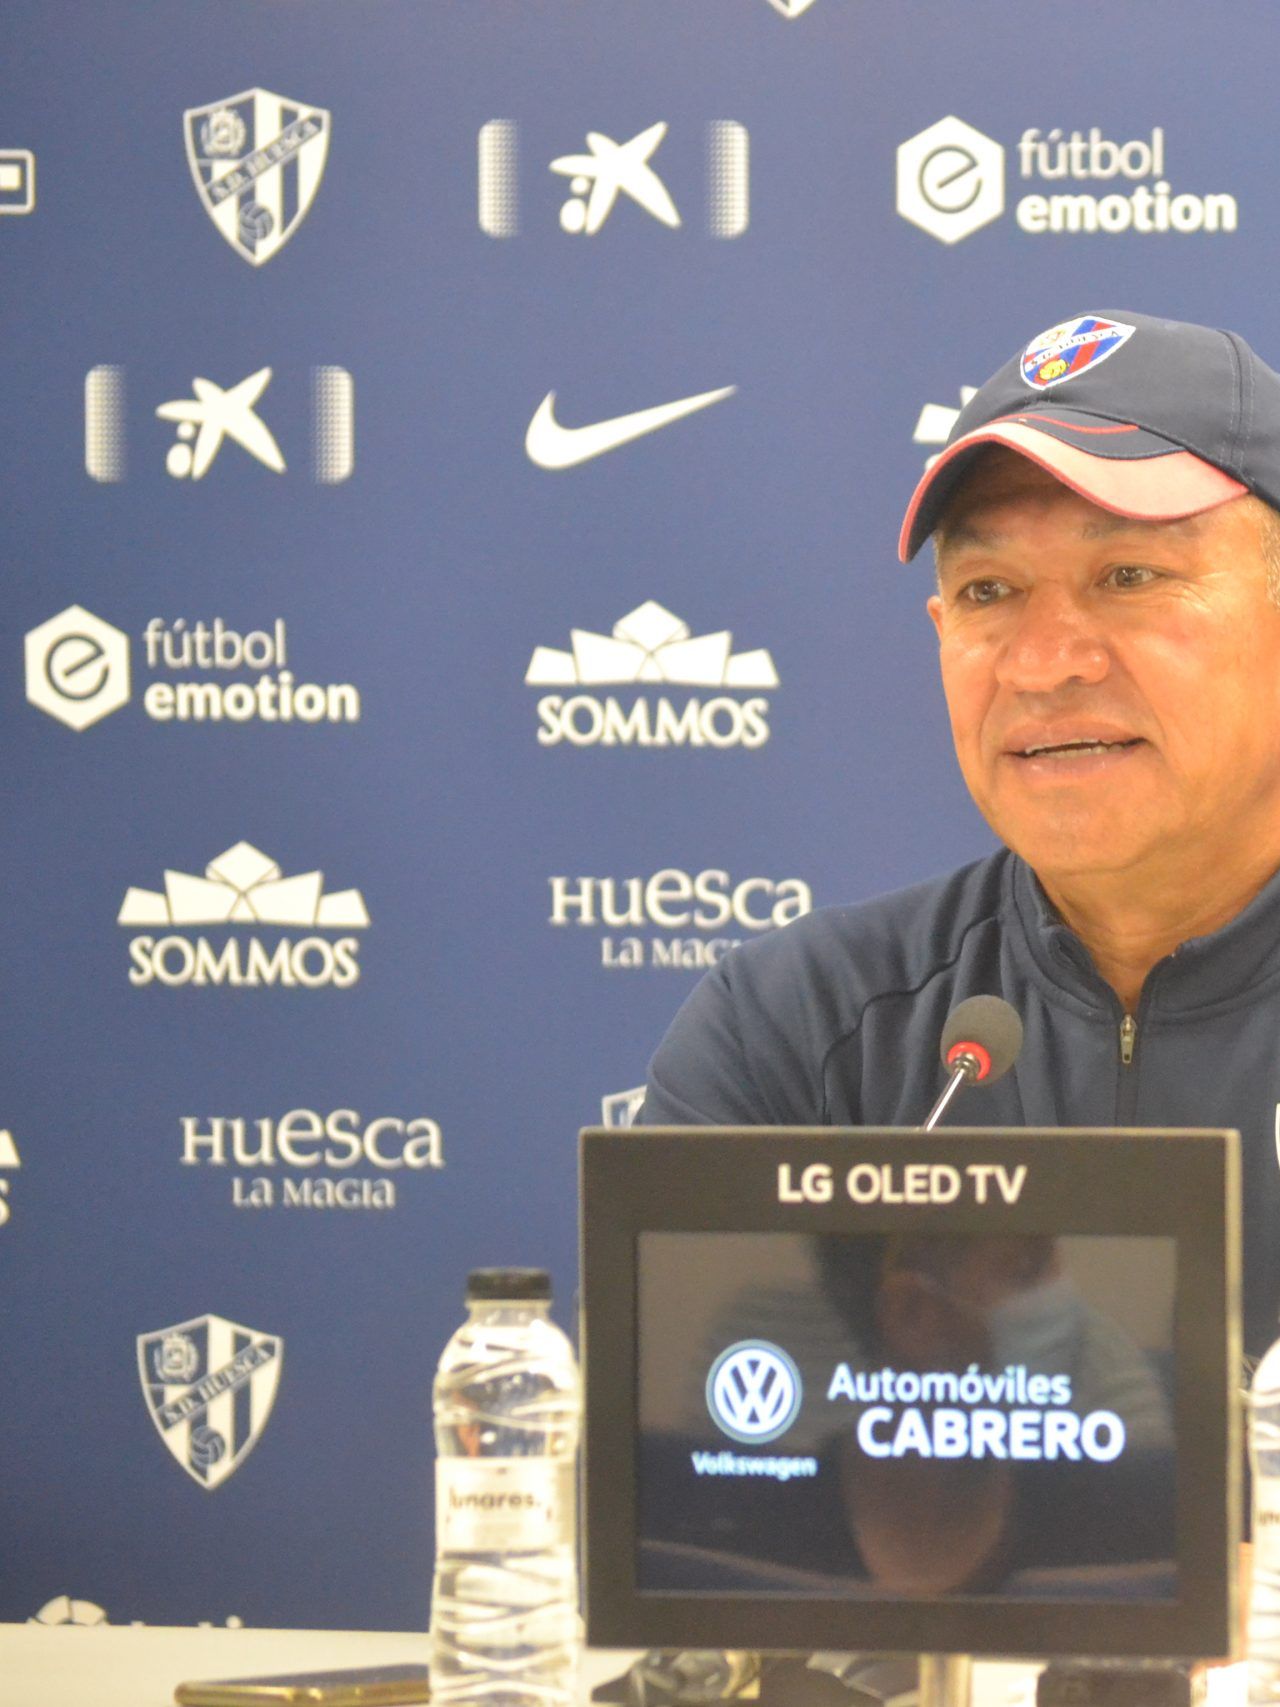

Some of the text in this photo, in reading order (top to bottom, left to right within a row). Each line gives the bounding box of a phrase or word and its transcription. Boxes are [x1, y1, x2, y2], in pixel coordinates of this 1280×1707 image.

[1018, 128, 1163, 179] fútbol
[1017, 181, 1237, 233] emotion
[144, 618, 292, 670] fútbol
[144, 671, 359, 721] emotion
[538, 696, 769, 747] SOMMOS
[129, 936, 359, 987] SOMMOS
[182, 1110, 443, 1168] Huesca
[778, 1164, 1027, 1203] LG OLED TV
[828, 1364, 1071, 1405] Automóviles
[858, 1407, 1125, 1461] CABRERO
[692, 1452, 816, 1480] Volkswagen
